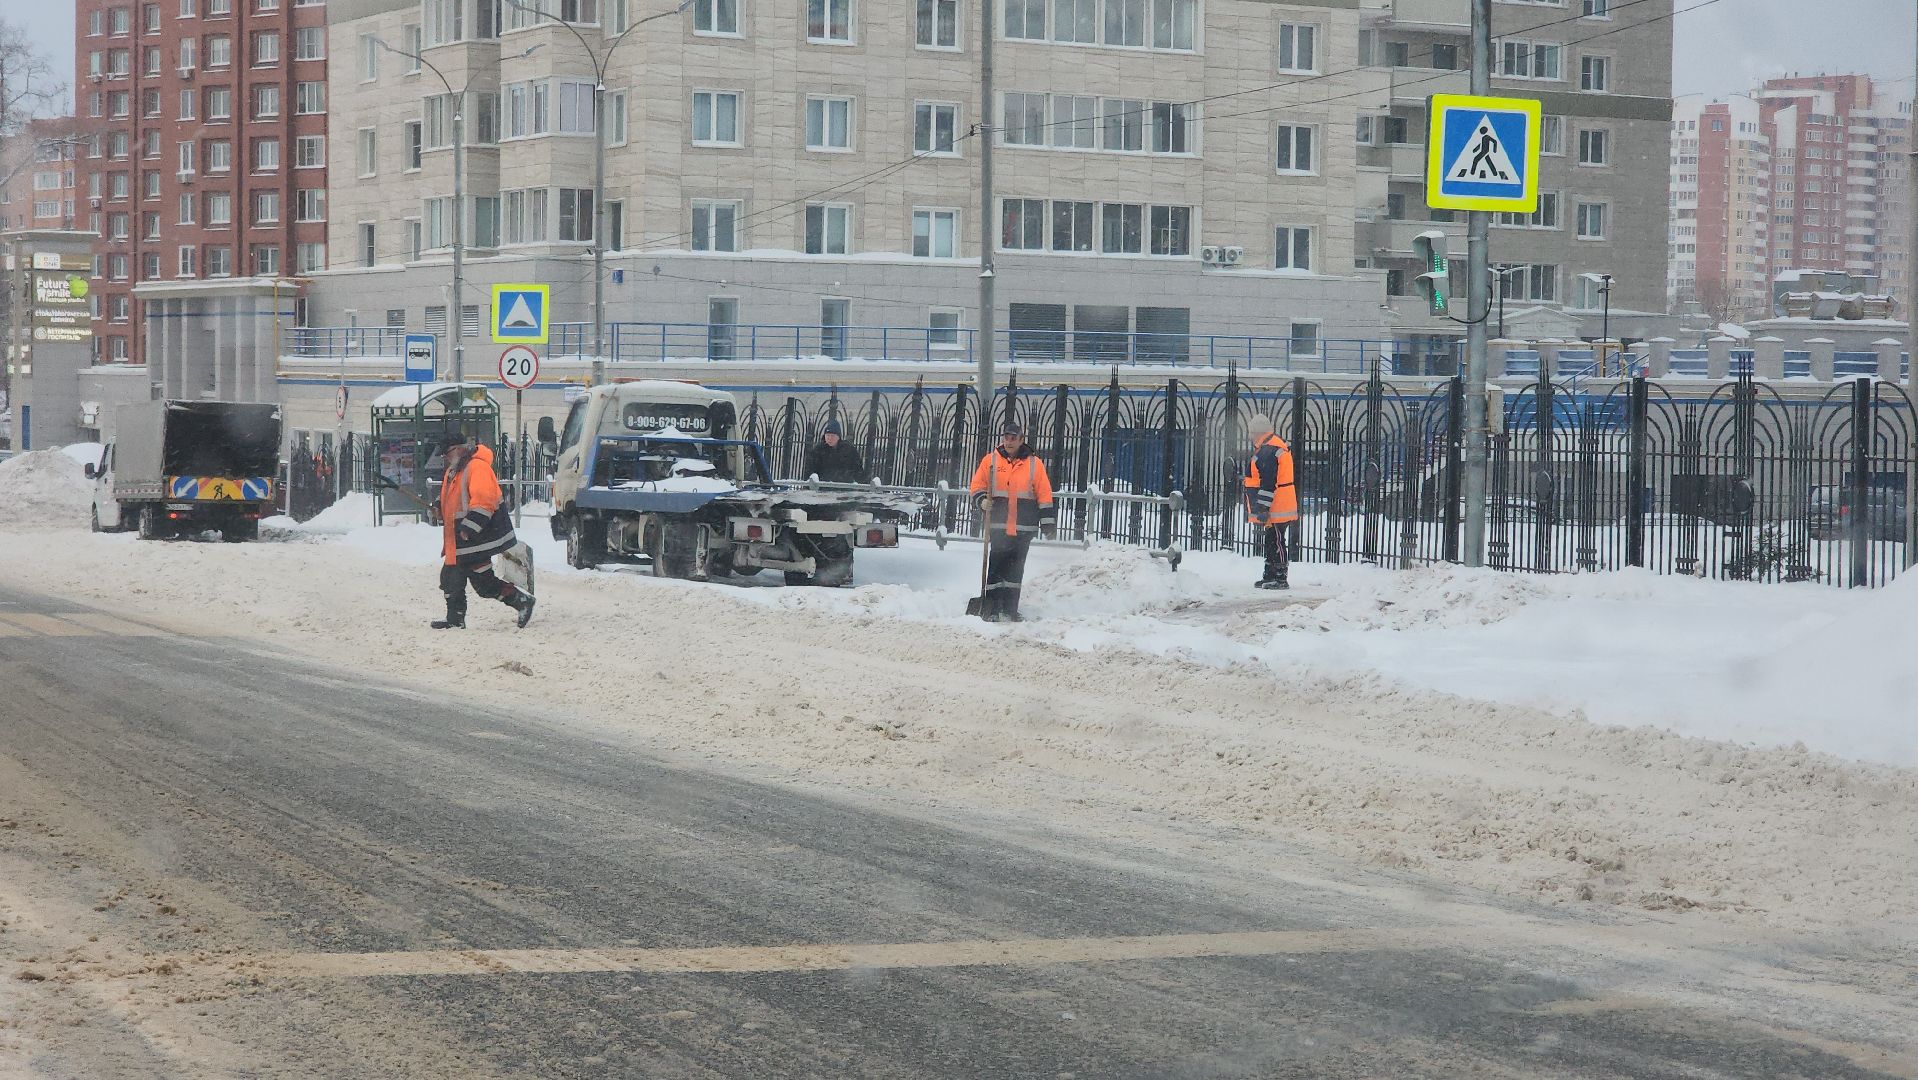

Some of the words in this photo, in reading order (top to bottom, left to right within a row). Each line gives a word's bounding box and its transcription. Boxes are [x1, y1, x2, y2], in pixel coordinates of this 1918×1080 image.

[37, 277, 70, 289] Future
[46, 288, 71, 297] smile
[507, 357, 531, 376] 20
[627, 415, 706, 430] 8-909-629-67-06
